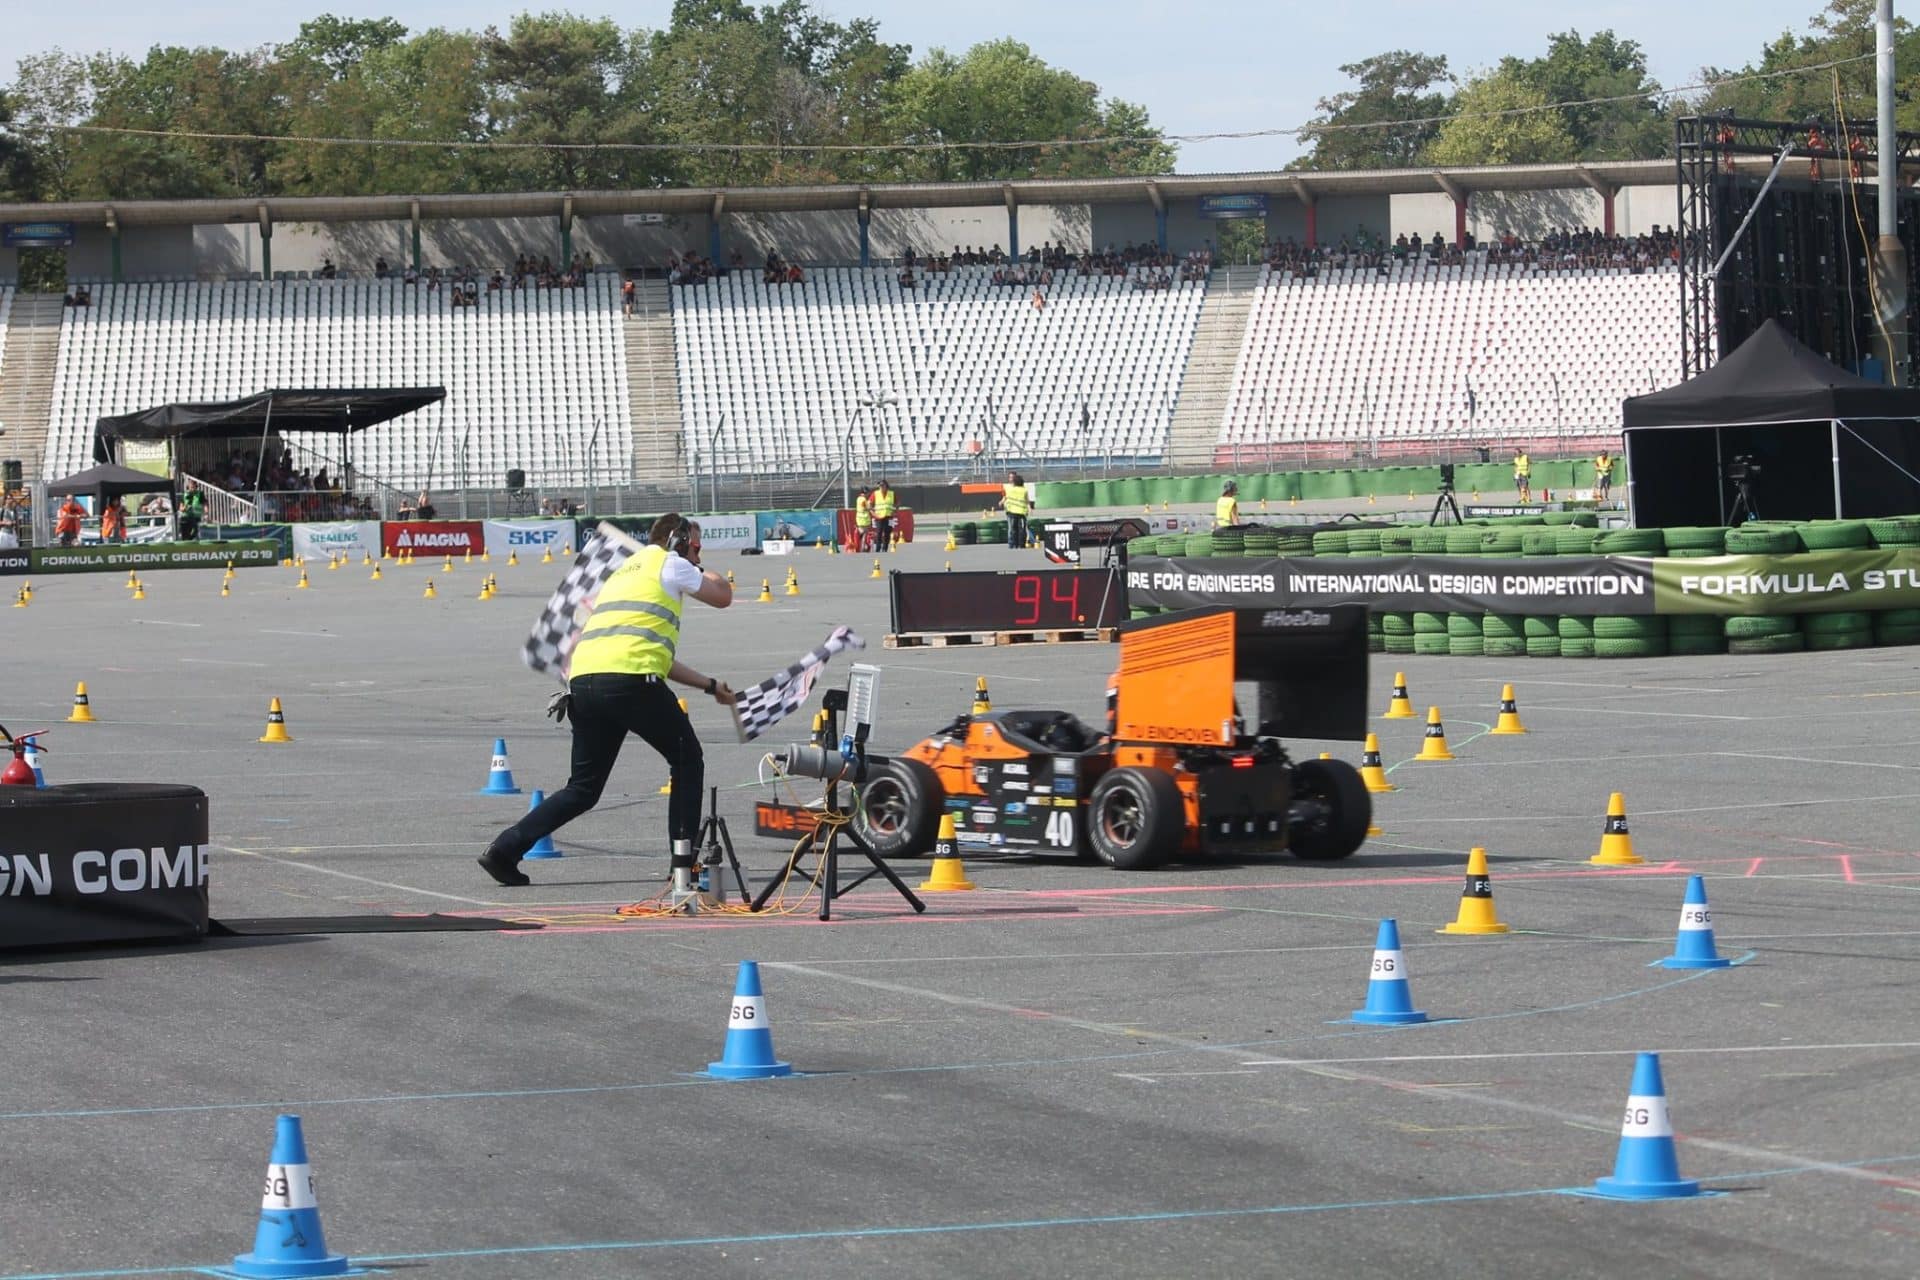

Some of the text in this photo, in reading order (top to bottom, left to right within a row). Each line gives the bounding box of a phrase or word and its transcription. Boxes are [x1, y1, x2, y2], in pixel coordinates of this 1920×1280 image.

[310, 532, 358, 543] SIEMENS
[413, 532, 470, 546] MAGNA
[508, 530, 558, 545] SKF
[41, 555, 104, 566] FORMULA
[108, 553, 167, 564] STUDENT
[172, 551, 237, 562] GERMANY
[242, 550, 272, 559] 2019
[1153, 573, 1183, 591] FOR
[1187, 574, 1275, 592] ENGINEERS
[1289, 574, 1424, 593] INTERNATIONAL
[1429, 575, 1497, 594] DESIGN
[1503, 576, 1644, 595] COMPETITION
[1681, 572, 1850, 595] FORMULA
[1045, 811, 1073, 847] 40
[1686, 910, 1712, 923] FSG
